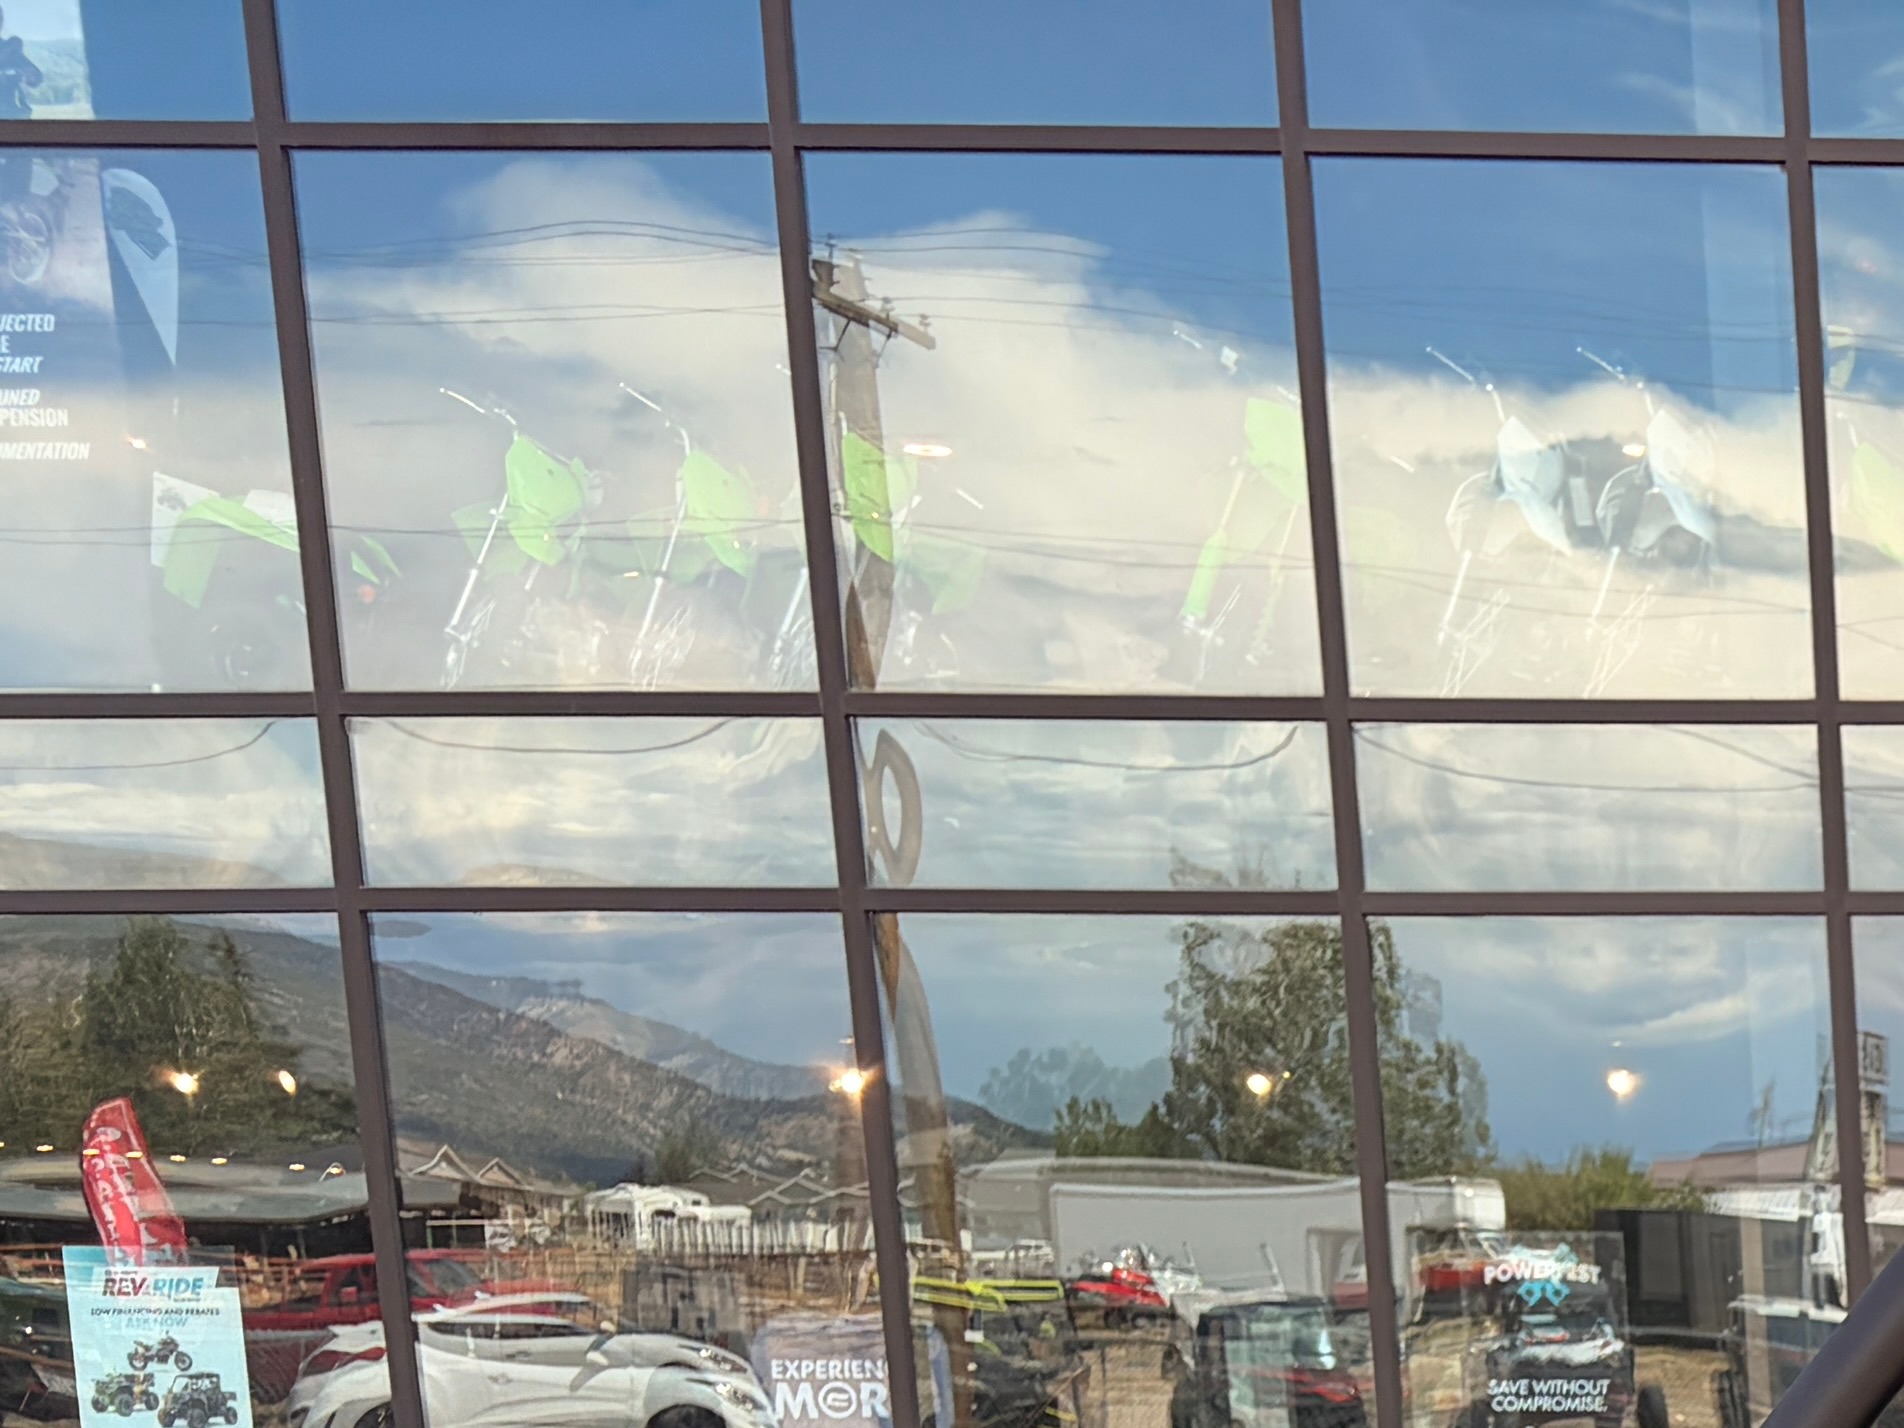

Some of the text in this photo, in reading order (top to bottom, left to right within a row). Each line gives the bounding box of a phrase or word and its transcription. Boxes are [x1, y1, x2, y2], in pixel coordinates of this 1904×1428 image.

[101, 1277, 205, 1298] REV RIDE
[770, 1358, 889, 1380] EXPERIEN
[1488, 1378, 1611, 1396] SAVE WITHOUT
[774, 1381, 890, 1420] MOR
